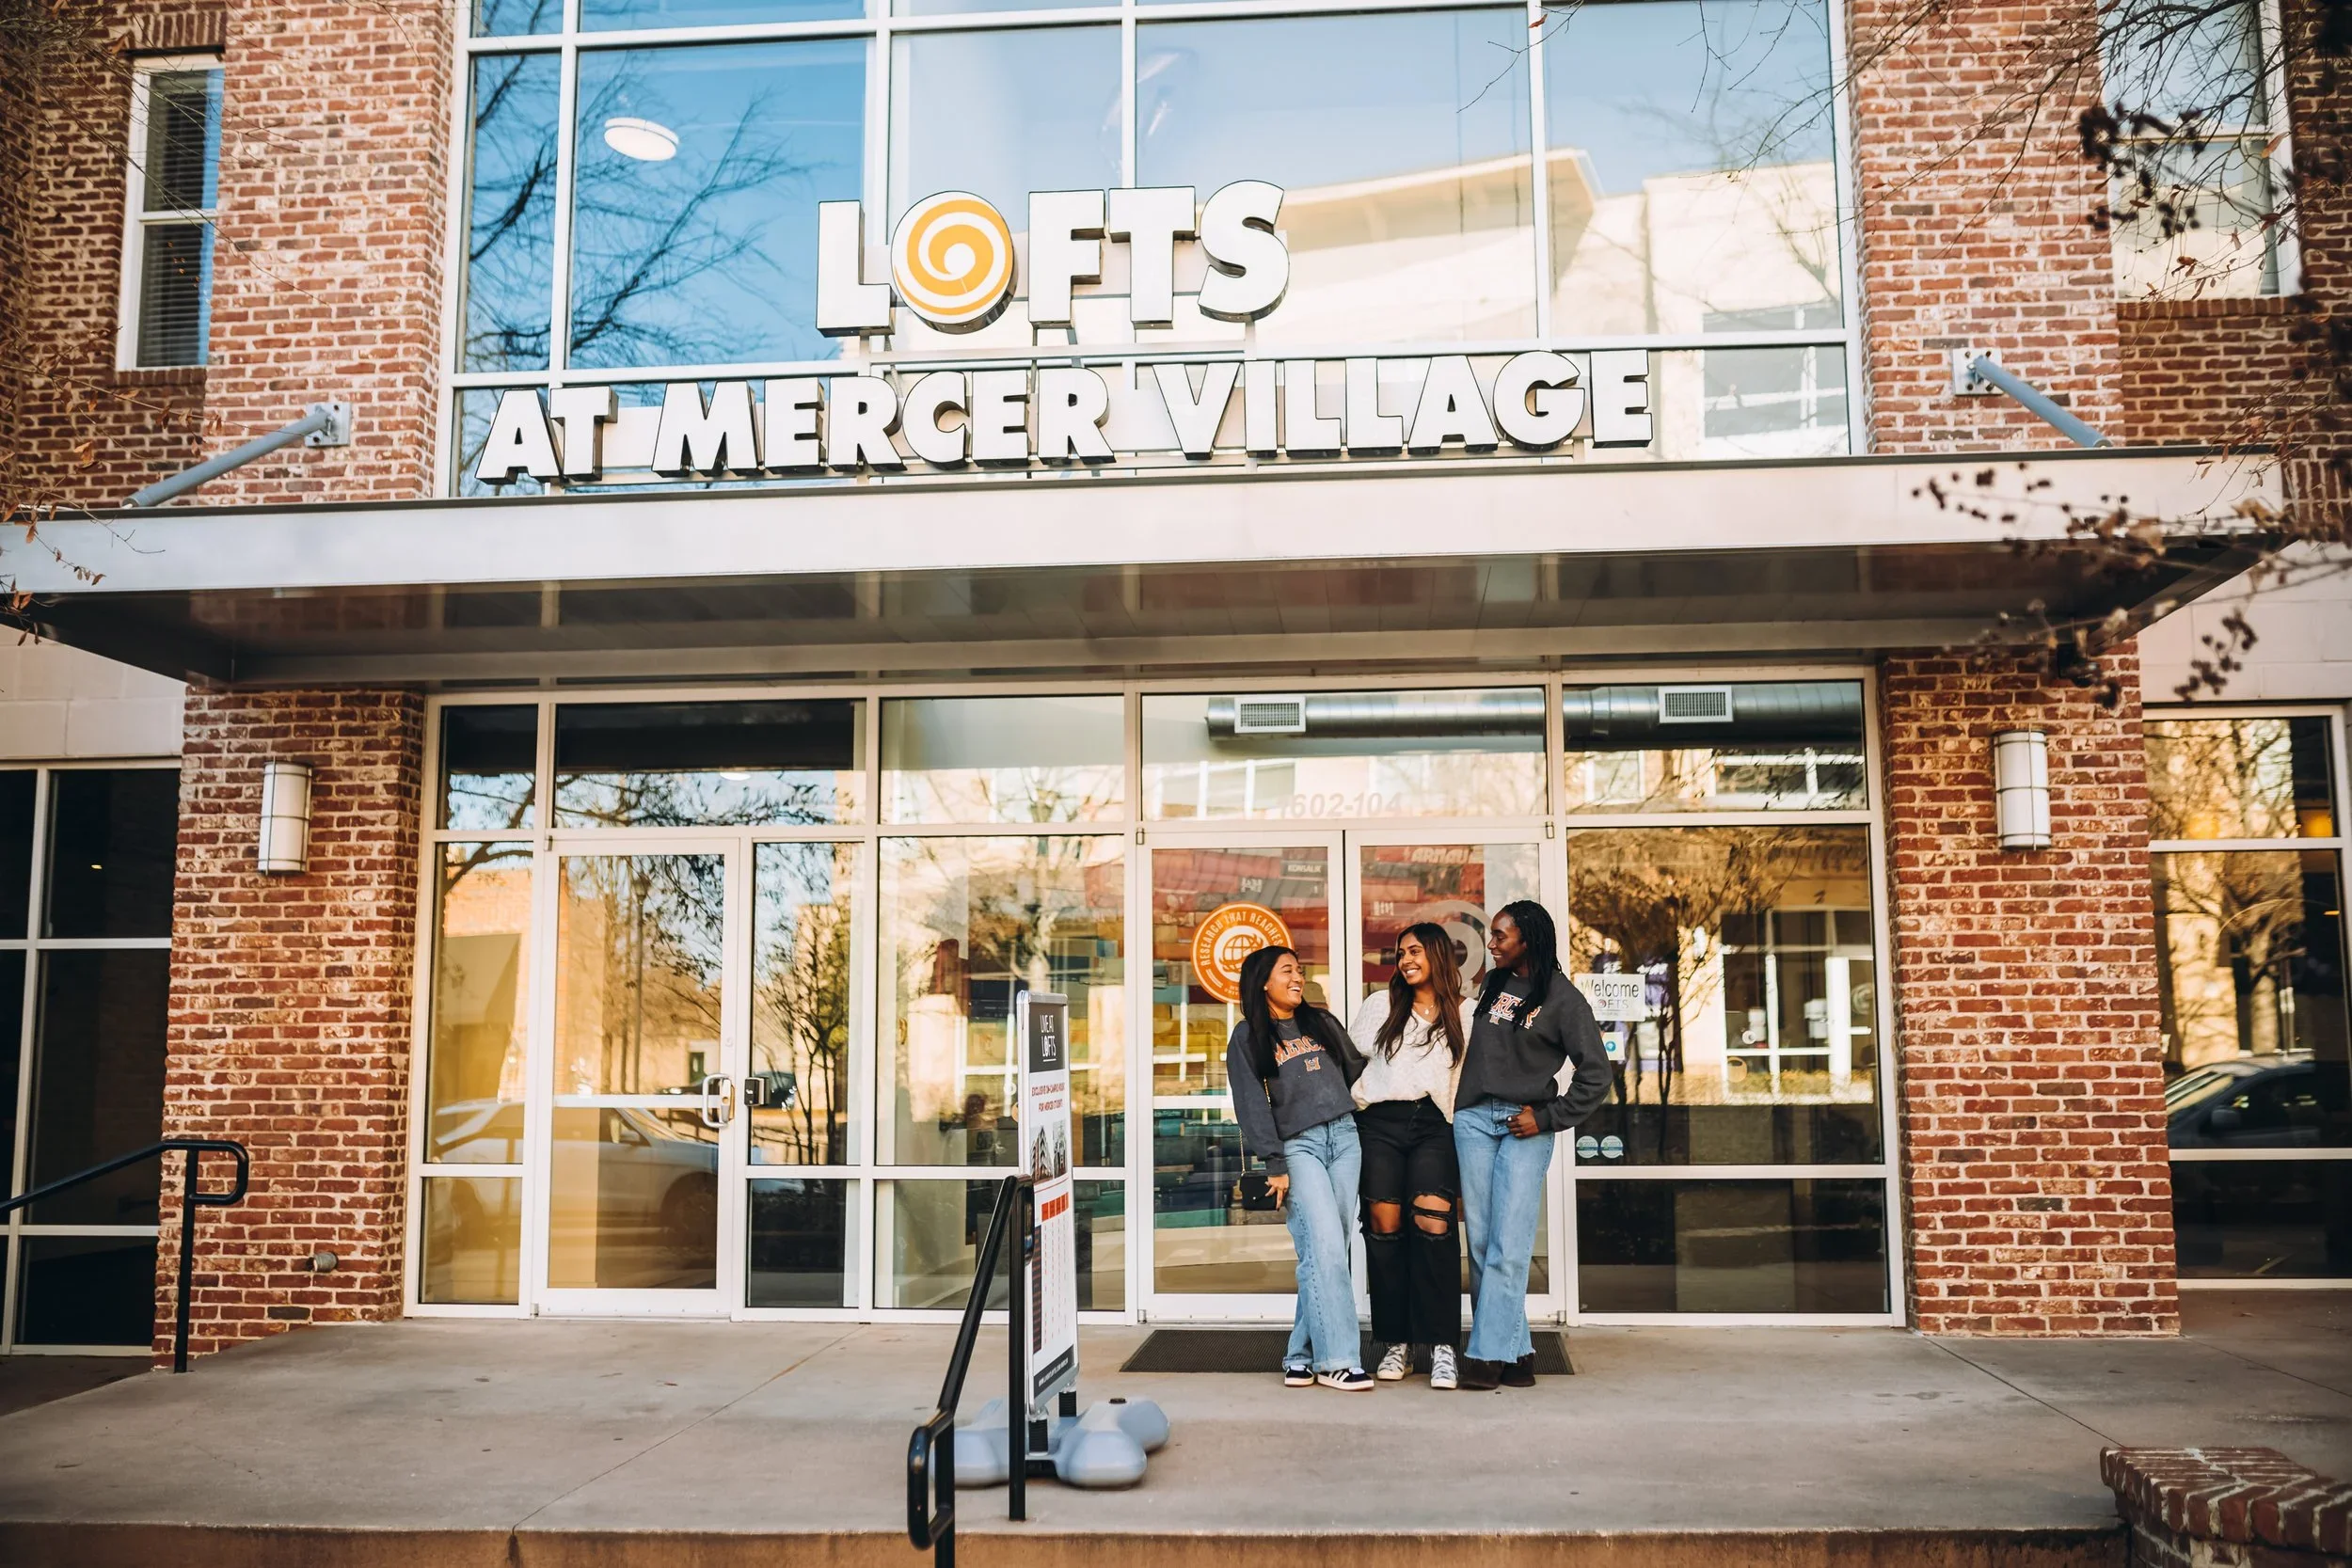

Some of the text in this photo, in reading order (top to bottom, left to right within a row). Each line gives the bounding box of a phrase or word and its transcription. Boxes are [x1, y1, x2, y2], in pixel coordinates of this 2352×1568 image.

[816, 180, 1290, 338] LOFTS
[475, 349, 1653, 484] AT MERCER VILLAGE
[1200, 911, 1284, 967] RESEARCH THAT REACHES
[1581, 979, 1639, 997] Welcome
[1041, 1035, 1057, 1057] LOFTS
